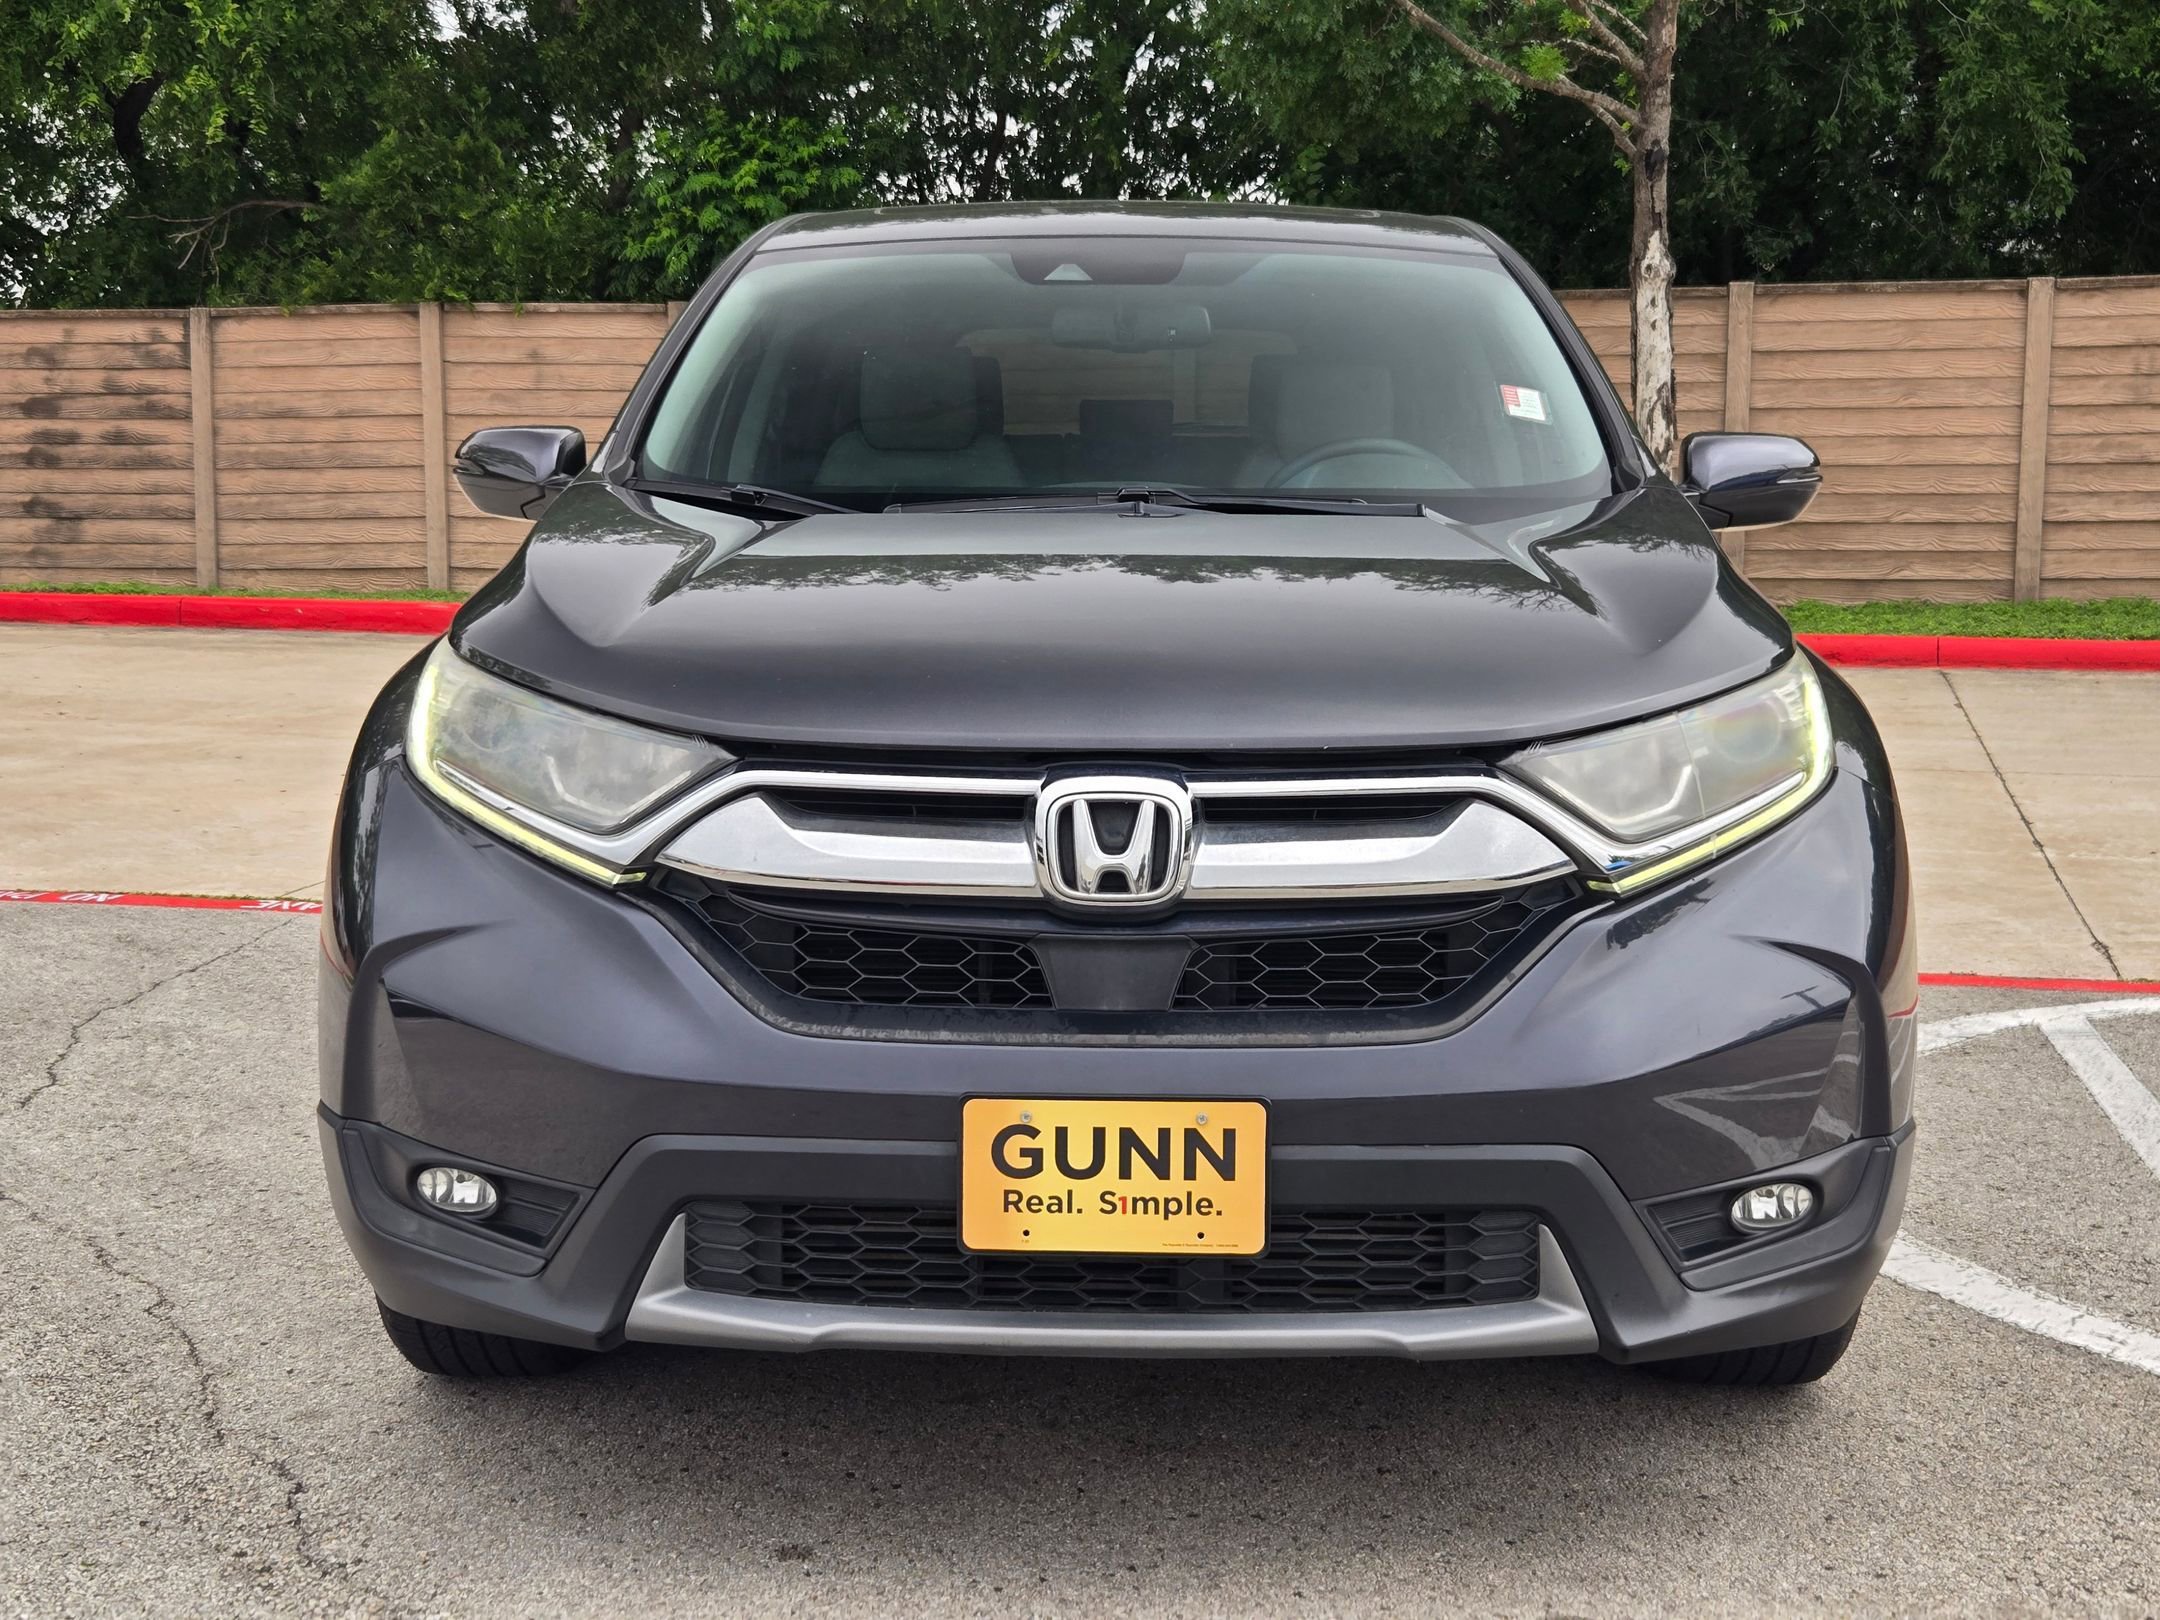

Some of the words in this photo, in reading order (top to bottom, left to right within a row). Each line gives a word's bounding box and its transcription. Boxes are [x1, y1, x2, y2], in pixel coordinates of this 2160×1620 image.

[240, 900, 323, 911] ANE
[991, 1124, 1236, 1181] GUNN
[1003, 1189, 1083, 1214] Real.
[1099, 1190, 1223, 1220] S1mple.
